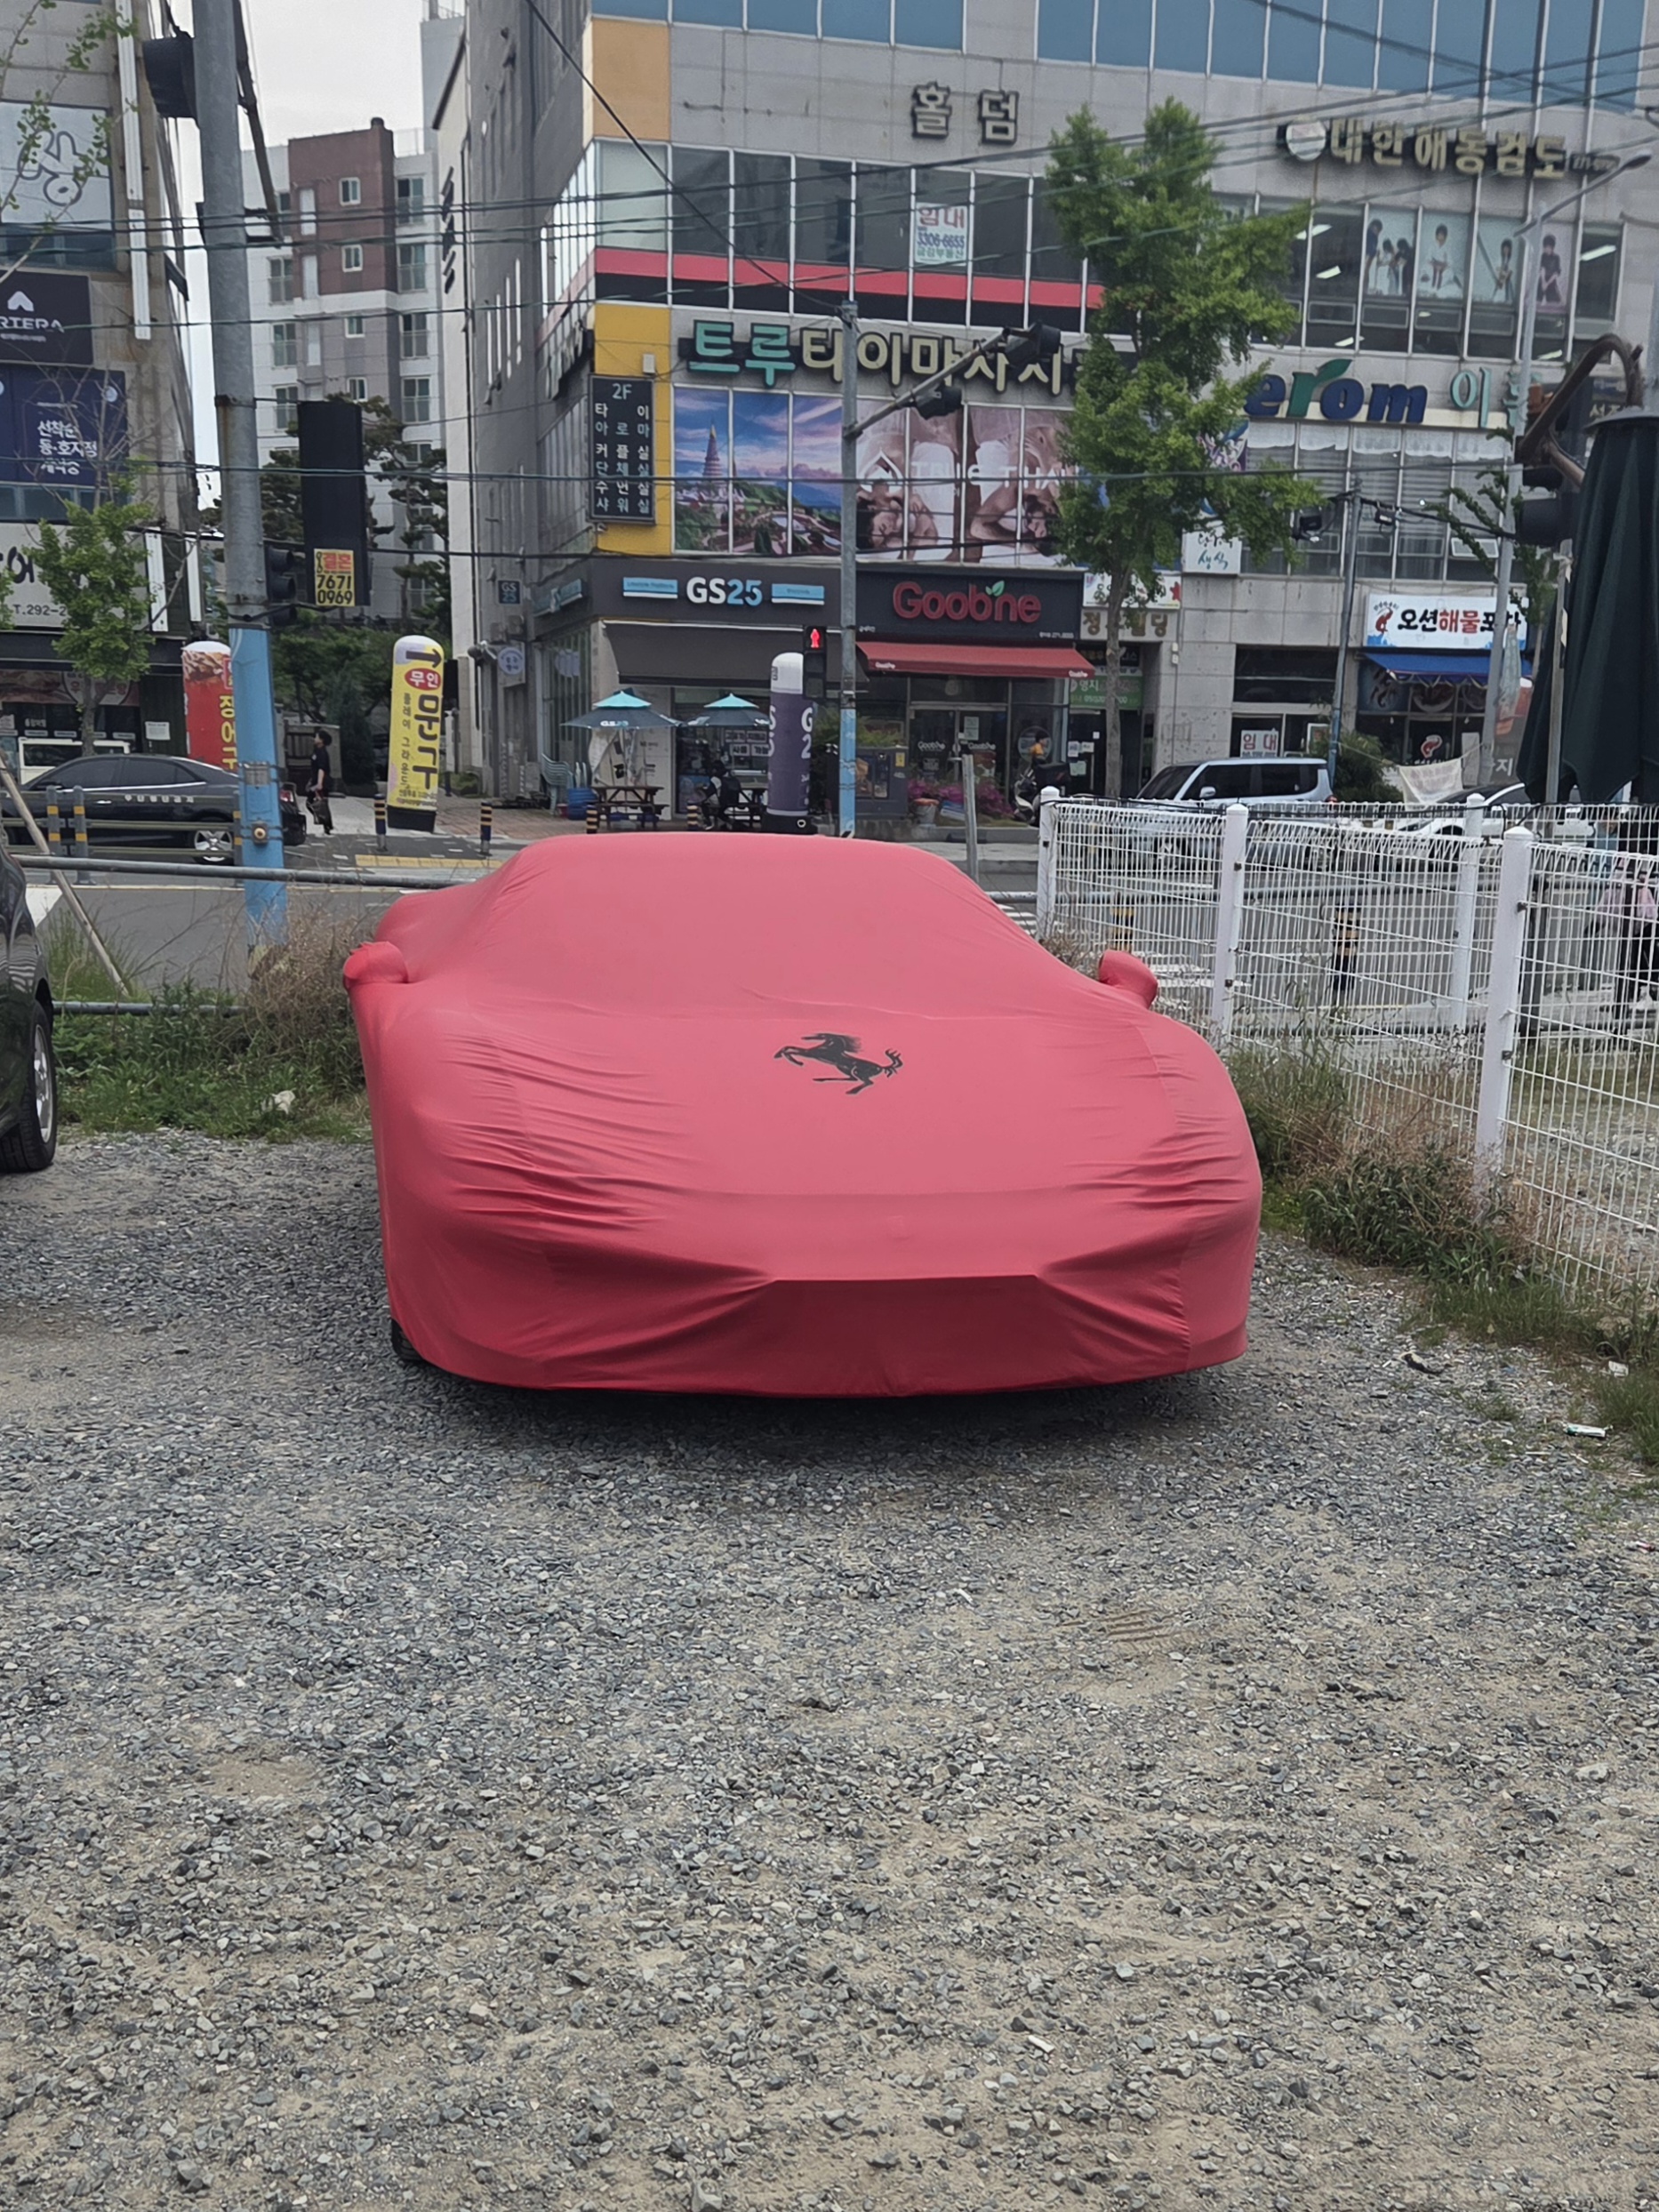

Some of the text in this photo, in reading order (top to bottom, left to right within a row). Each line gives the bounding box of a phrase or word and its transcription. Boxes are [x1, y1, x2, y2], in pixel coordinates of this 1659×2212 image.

[912, 84, 1017, 142] 홀덤
[918, 205, 966, 228] 임대
[612, 382, 632, 400] 2F
[595, 421, 650, 437] 아로마
[595, 443, 649, 461] 커플실
[596, 461, 650, 478] 단체실
[595, 480, 649, 496] 수면실
[596, 497, 650, 514] 샤워실
[317, 574, 351, 589] 7671
[501, 582, 517, 592] GS
[317, 589, 353, 605] 0969
[686, 577, 763, 606] GS25
[893, 581, 1042, 623] Goobne
[410, 670, 438, 688] 무인
[1243, 733, 1277, 750] 임대
